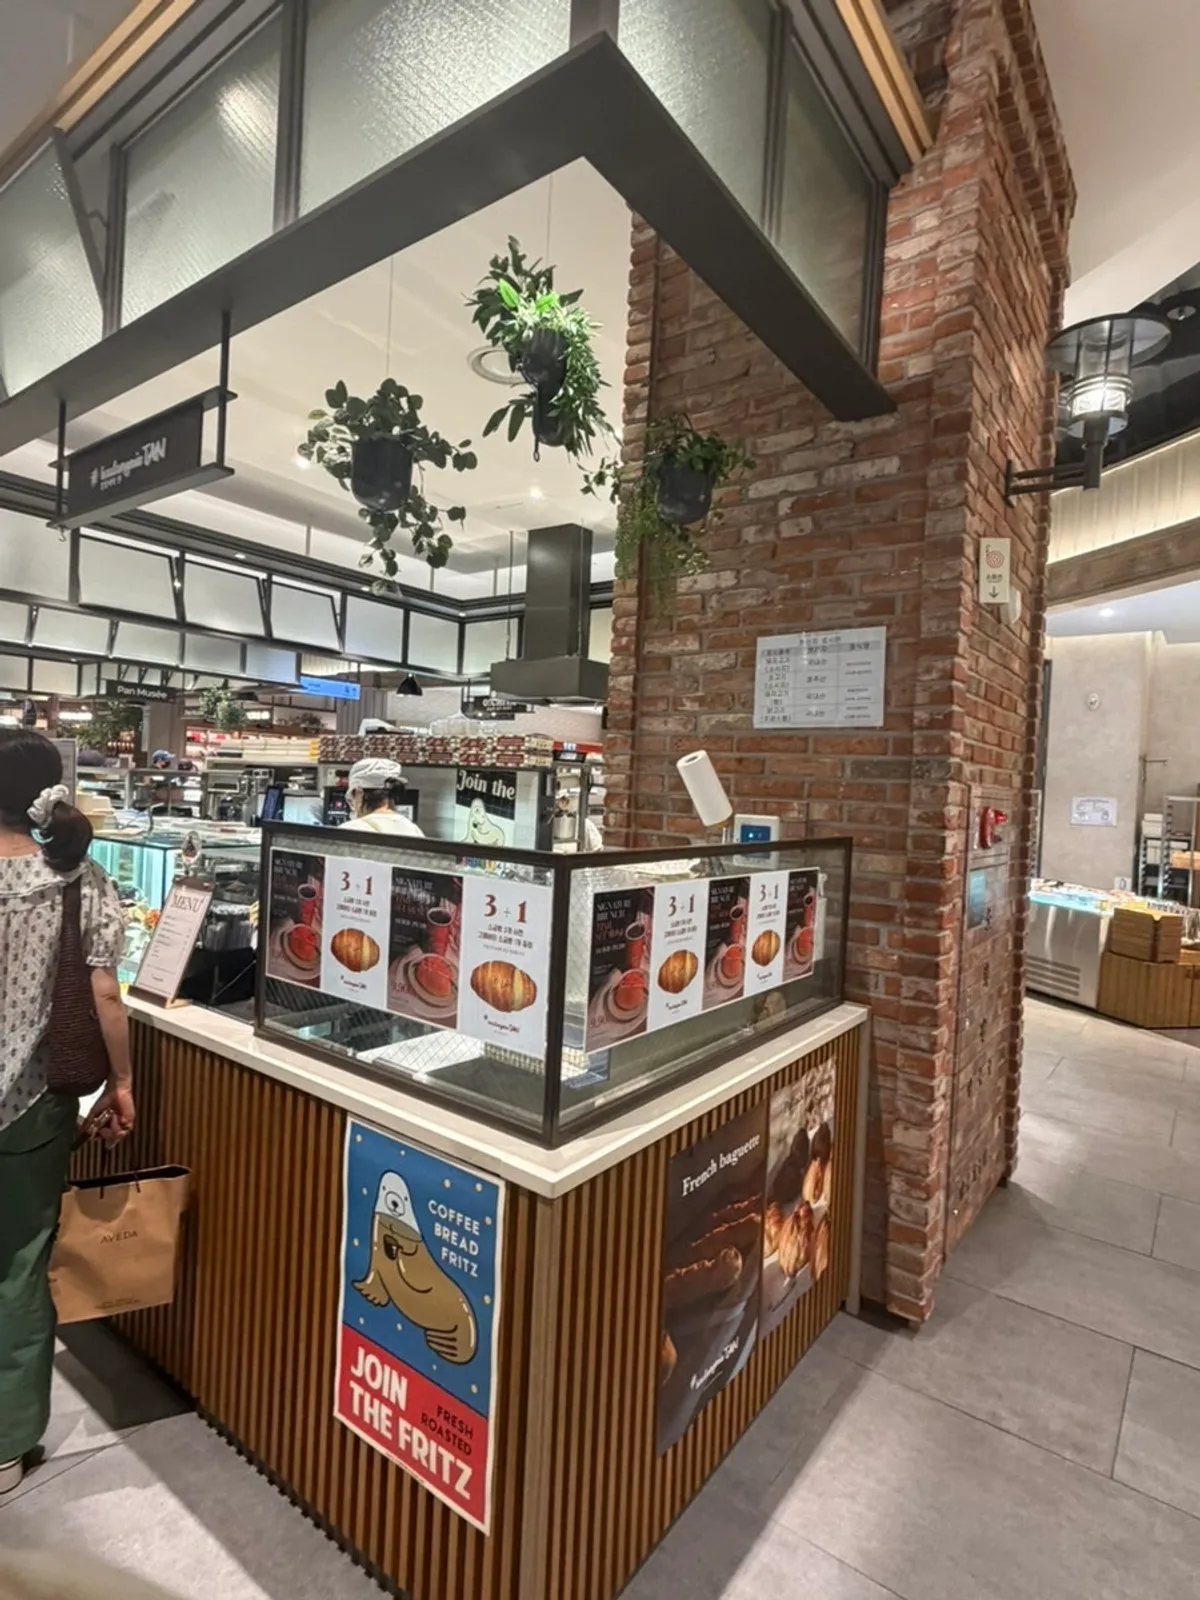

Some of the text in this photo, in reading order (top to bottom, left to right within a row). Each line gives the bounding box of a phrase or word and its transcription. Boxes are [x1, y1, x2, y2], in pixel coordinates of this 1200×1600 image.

[457, 769, 517, 800] Join the
[340, 871, 350, 891] 3
[365, 876, 373, 895] 1
[760, 884, 767, 901] 3
[171, 893, 205, 913] MENU
[484, 894, 497, 917] 3
[517, 901, 527, 924] 1
[668, 895, 677, 917] 3
[688, 894, 695, 914] 1
[682, 1134, 761, 1197] French baguette
[428, 1199, 480, 1236] COFFEE
[101, 1230, 139, 1244] AVEDA
[434, 1222, 479, 1256] BREAD
[441, 1246, 479, 1278] FRITZ
[350, 1346, 408, 1411] JOIN
[420, 1412, 473, 1457] ROASTED
[436, 1405, 474, 1440] FRESH
[349, 1380, 393, 1441] THE
[398, 1417, 473, 1500] FRITZ
